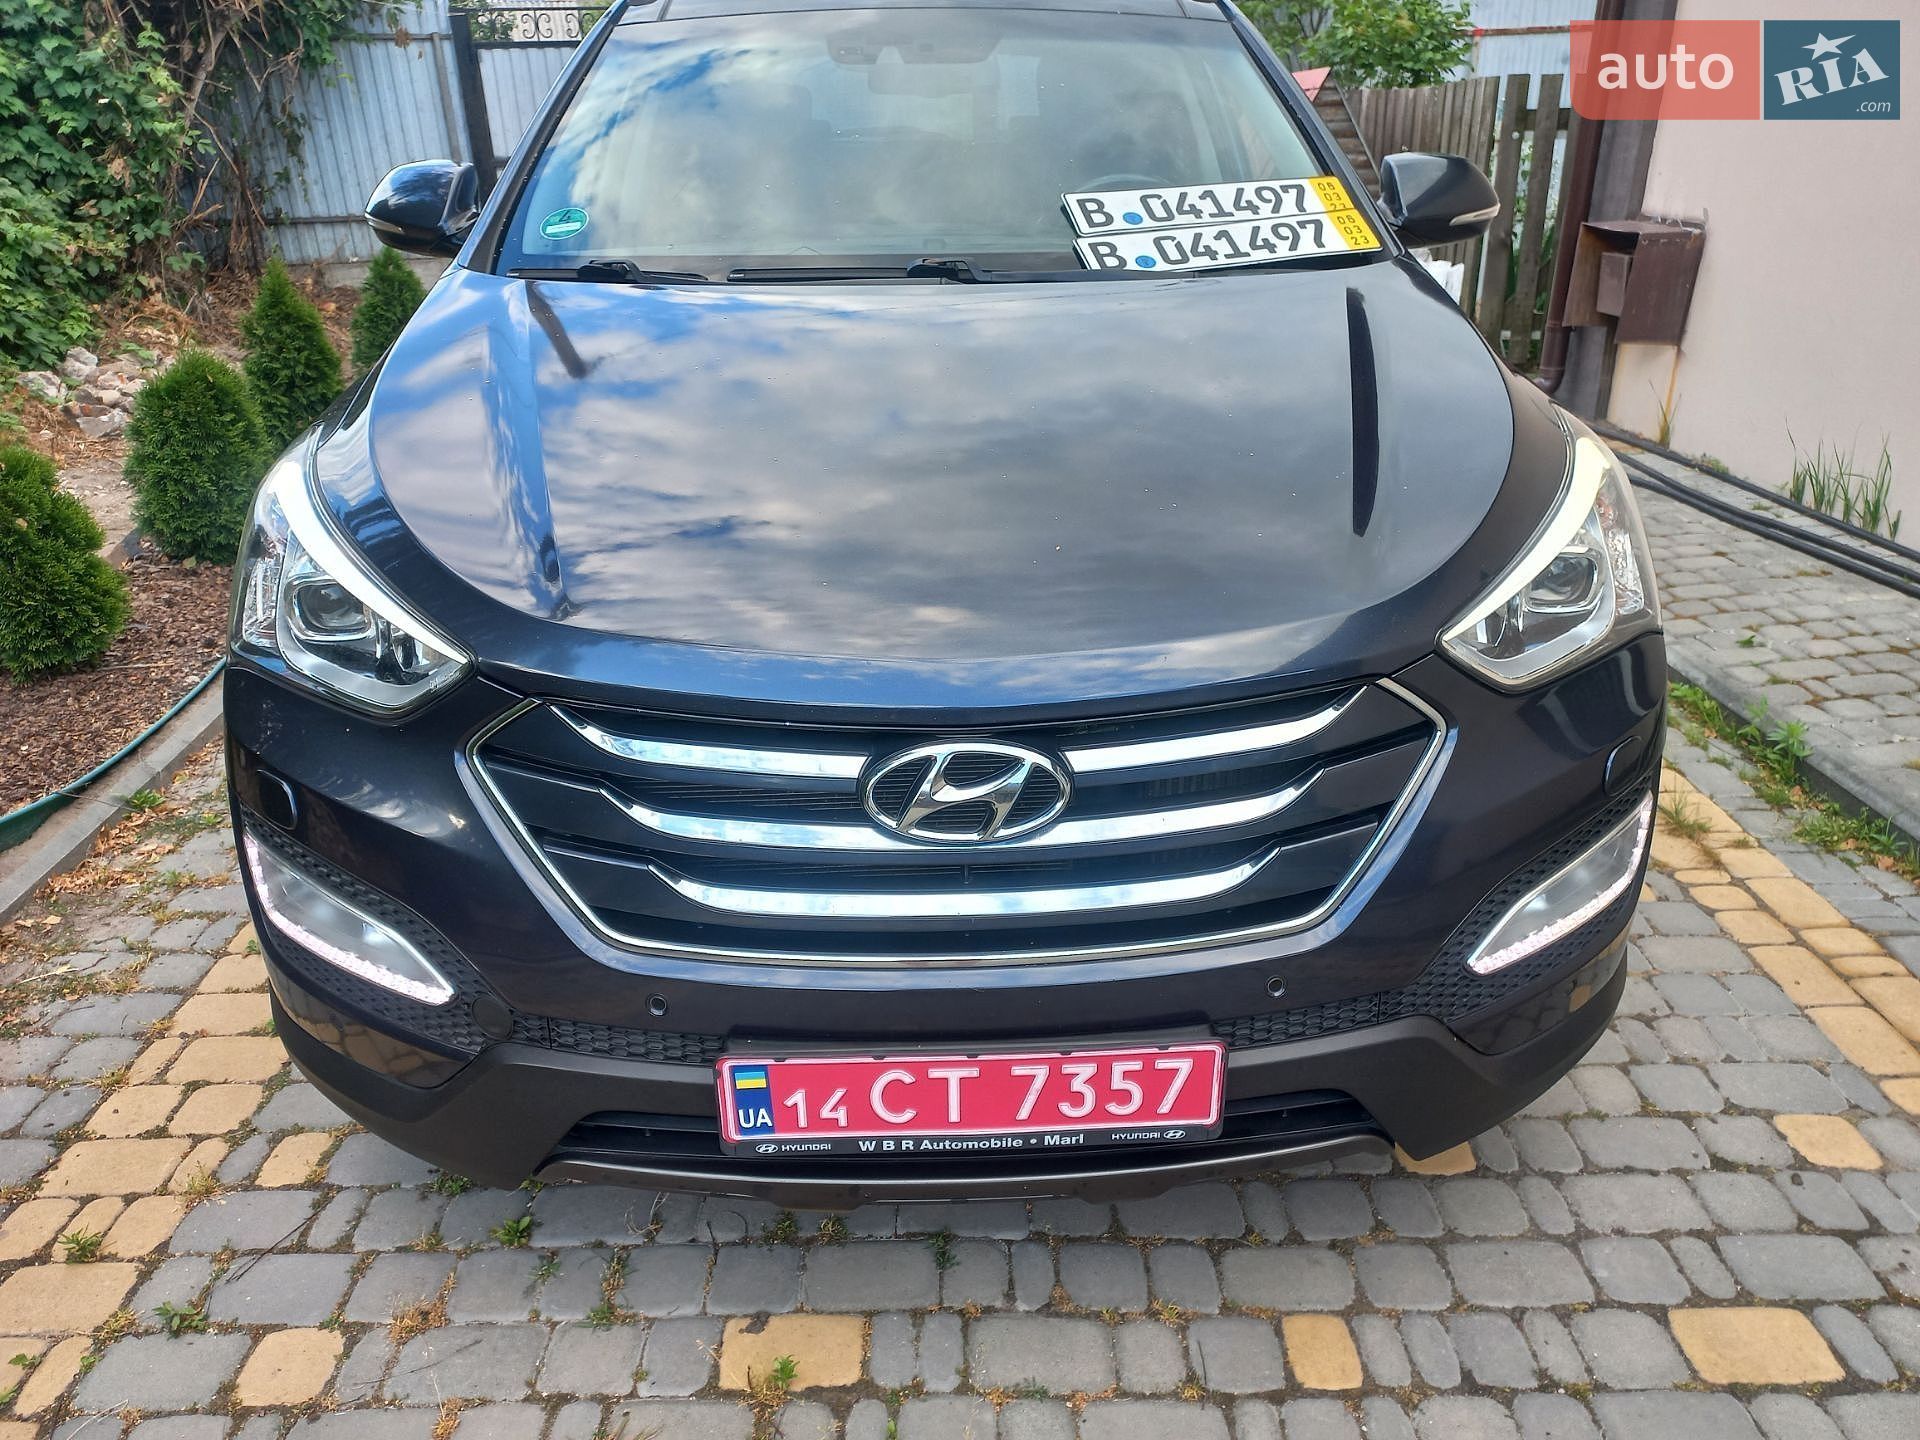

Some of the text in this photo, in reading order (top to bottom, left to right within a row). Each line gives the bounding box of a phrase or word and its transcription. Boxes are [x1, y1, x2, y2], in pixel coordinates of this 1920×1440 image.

[1317, 182, 1335, 191] 06
[1323, 192, 1341, 201] 03
[1076, 183, 1307, 228] B 041497
[1337, 215, 1355, 224] 06
[1344, 225, 1362, 234] 03
[1088, 218, 1325, 270] B 041497
[1351, 235, 1369, 245] 23
[783, 1088, 849, 1128] 14
[1010, 1058, 1194, 1121] 7357
[738, 1108, 773, 1128] UA
[1112, 1132, 1160, 1140] HYUNDAI
[920, 1137, 1023, 1150] Automobile
[1044, 1133, 1084, 1146] Marl
[782, 1143, 831, 1151] HYUNDAI
